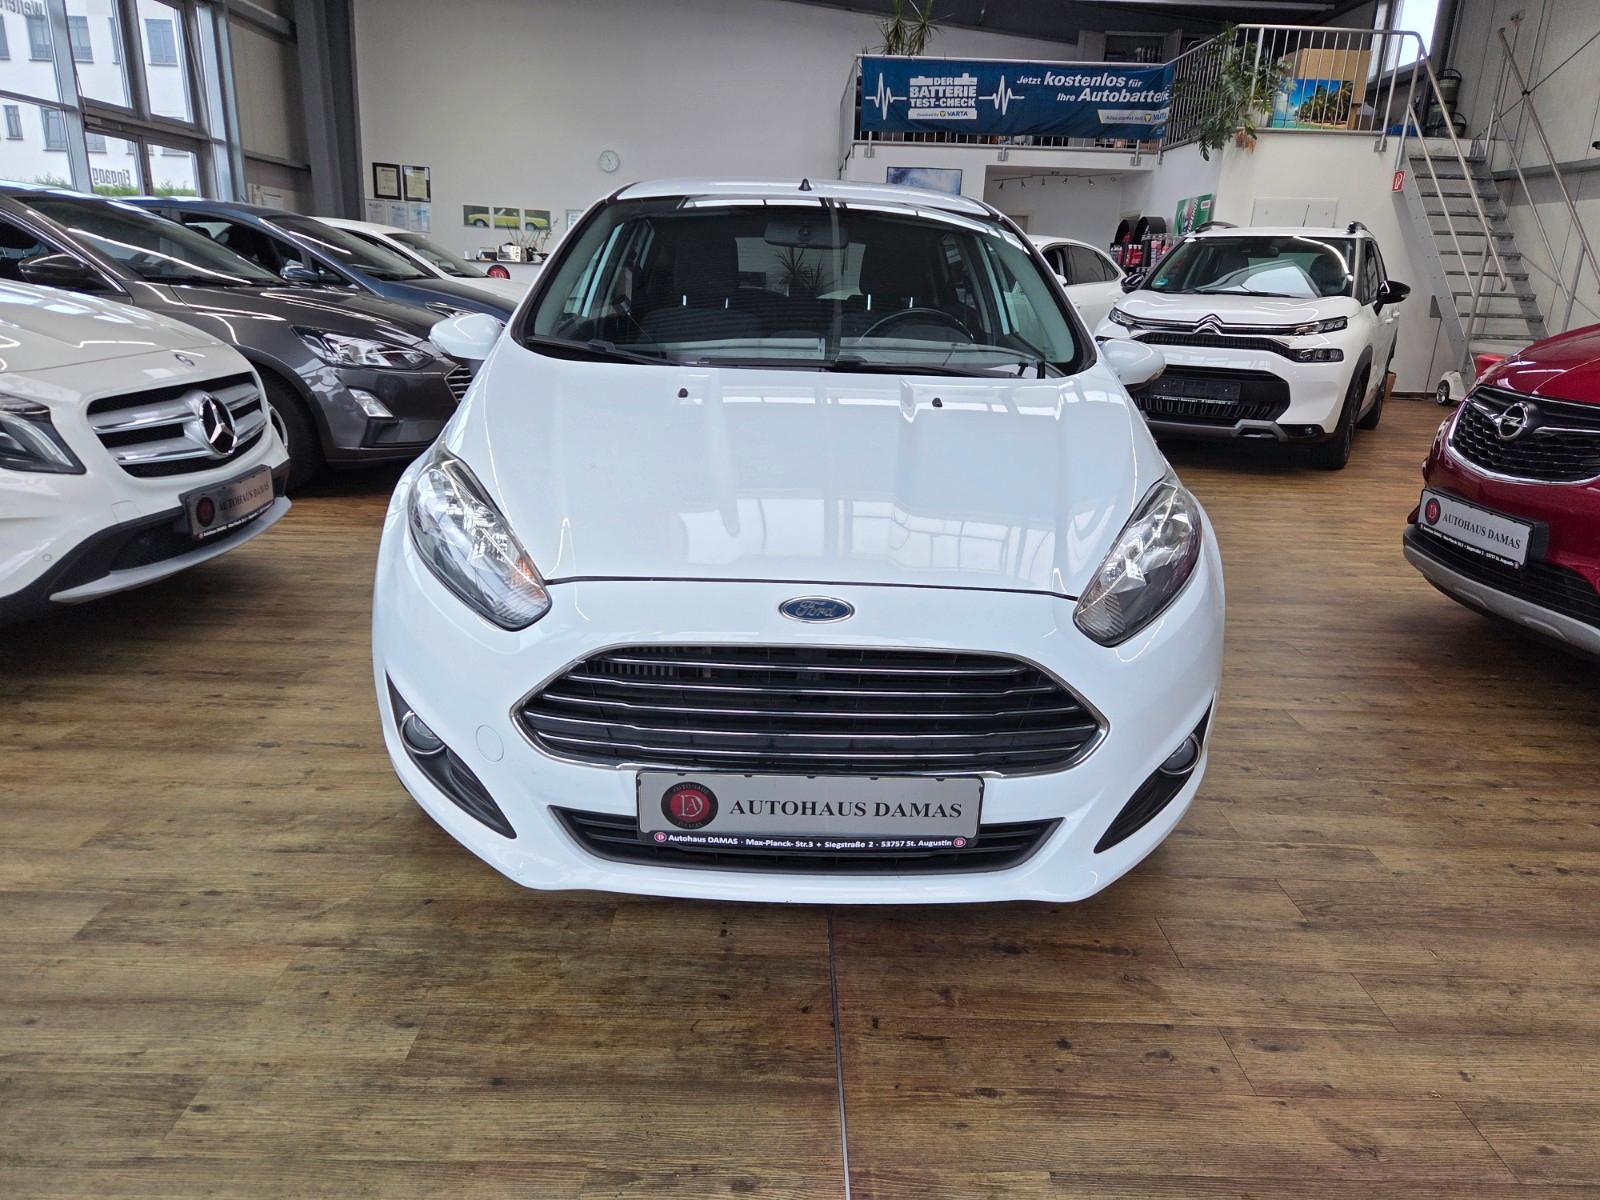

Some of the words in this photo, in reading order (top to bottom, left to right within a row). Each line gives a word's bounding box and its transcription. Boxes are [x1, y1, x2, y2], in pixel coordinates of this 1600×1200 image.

[933, 77, 953, 86] DER
[1016, 75, 1042, 85] Jetzt
[1044, 71, 1127, 88] kostenlos
[1128, 79, 1143, 88] für
[909, 86, 977, 98] BATTERIE
[1056, 92, 1076, 102] Ihre
[910, 98, 976, 108] TEST-CHECK
[1442, 513, 1486, 536] AUTOHAUS
[1487, 528, 1521, 550] DAMAS
[795, 600, 838, 617] Ford
[729, 799, 867, 817] AUTOHAUS
[873, 802, 962, 818] DAMAS
[668, 834, 706, 843] Autohaus
[707, 836, 738, 845] DAMAS
[824, 840, 866, 849] Siegstraße
[880, 840, 905, 848] 53757
[906, 839, 916, 847] St.
[917, 839, 952, 848] Augustin
